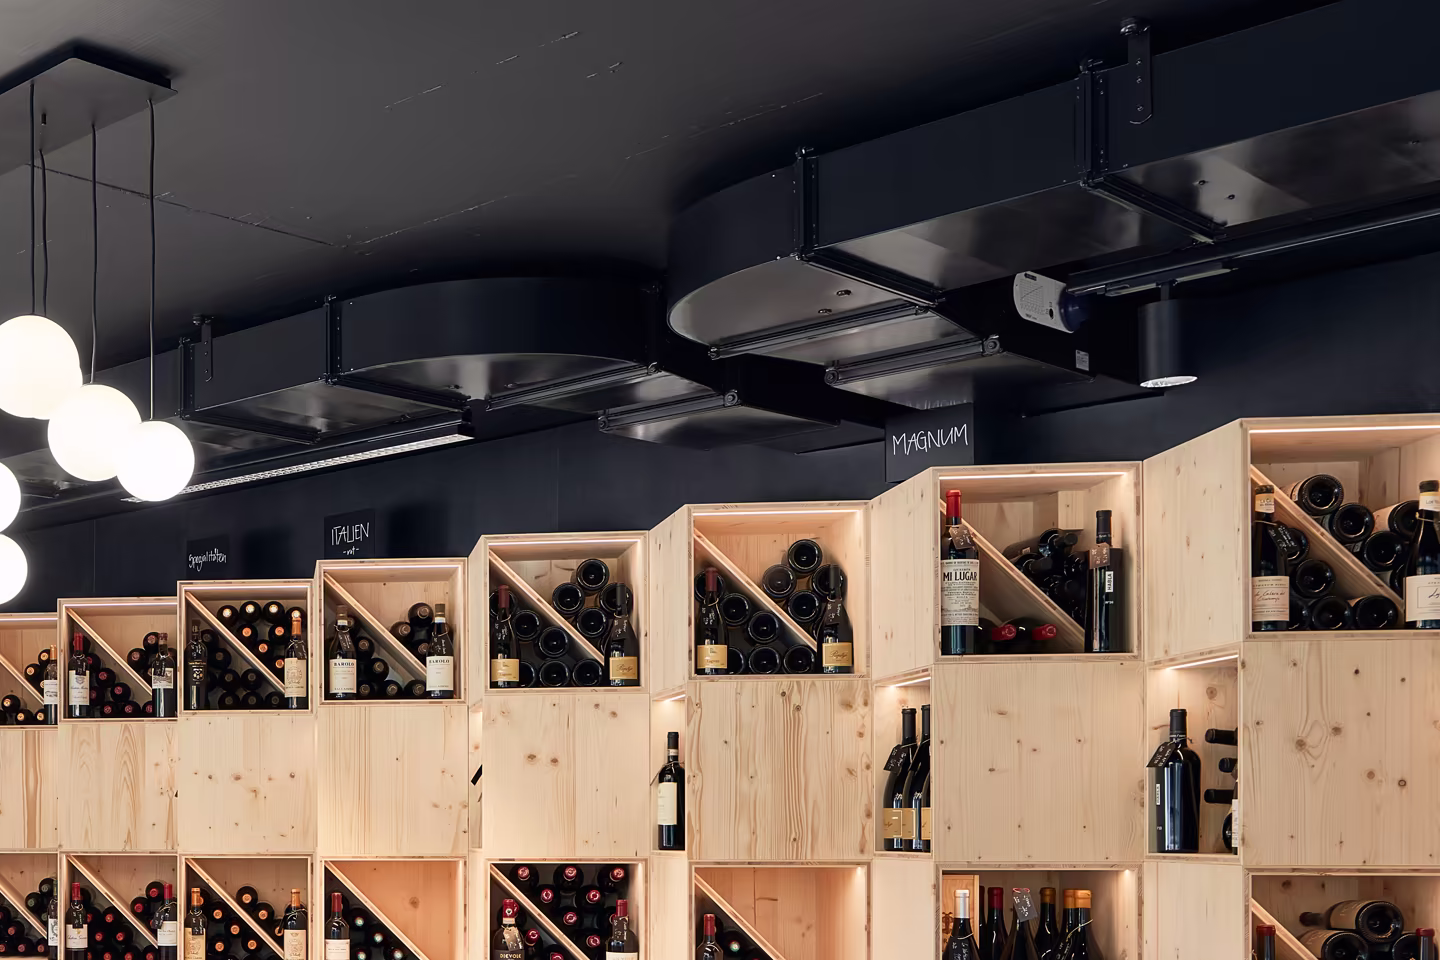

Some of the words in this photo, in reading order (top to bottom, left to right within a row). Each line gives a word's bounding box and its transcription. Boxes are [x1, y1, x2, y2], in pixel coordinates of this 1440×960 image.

[892, 423, 969, 456] MAGNUM
[331, 522, 370, 546] ITALIEN
[943, 572, 952, 581] MI
[954, 571, 978, 581] LUGAR
